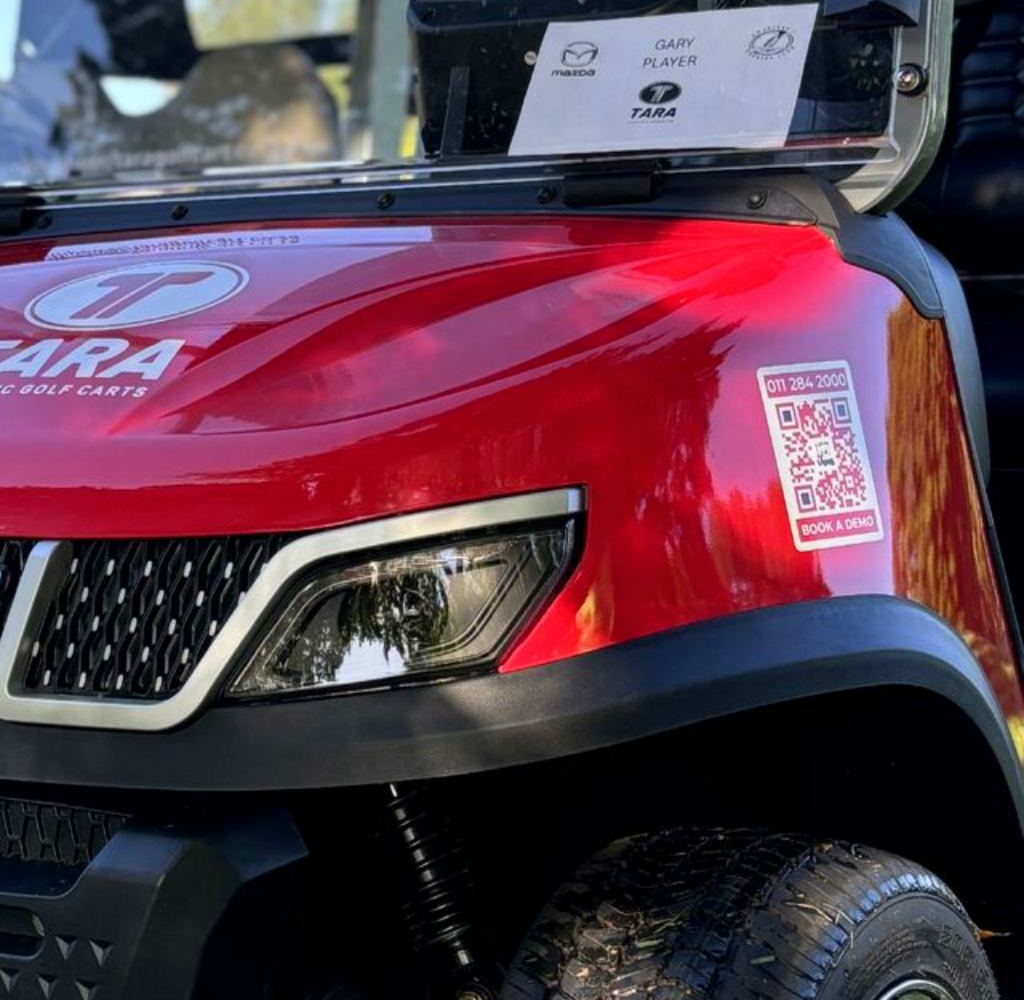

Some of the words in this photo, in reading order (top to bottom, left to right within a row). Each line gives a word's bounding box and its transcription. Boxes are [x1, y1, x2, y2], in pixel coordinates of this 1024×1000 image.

[654, 37, 696, 50] GARY
[642, 55, 698, 68] PLAYER
[551, 69, 596, 77] mazda
[631, 107, 677, 119] TARA
[767, 379, 787, 393] 011
[789, 376, 814, 392] 284
[816, 373, 847, 388] 2000
[19, 384, 75, 396] GOLF
[76, 384, 149, 398] CARTS
[800, 522, 833, 536] BOOK
[835, 520, 844, 531] A
[845, 515, 875, 530] DEMO
